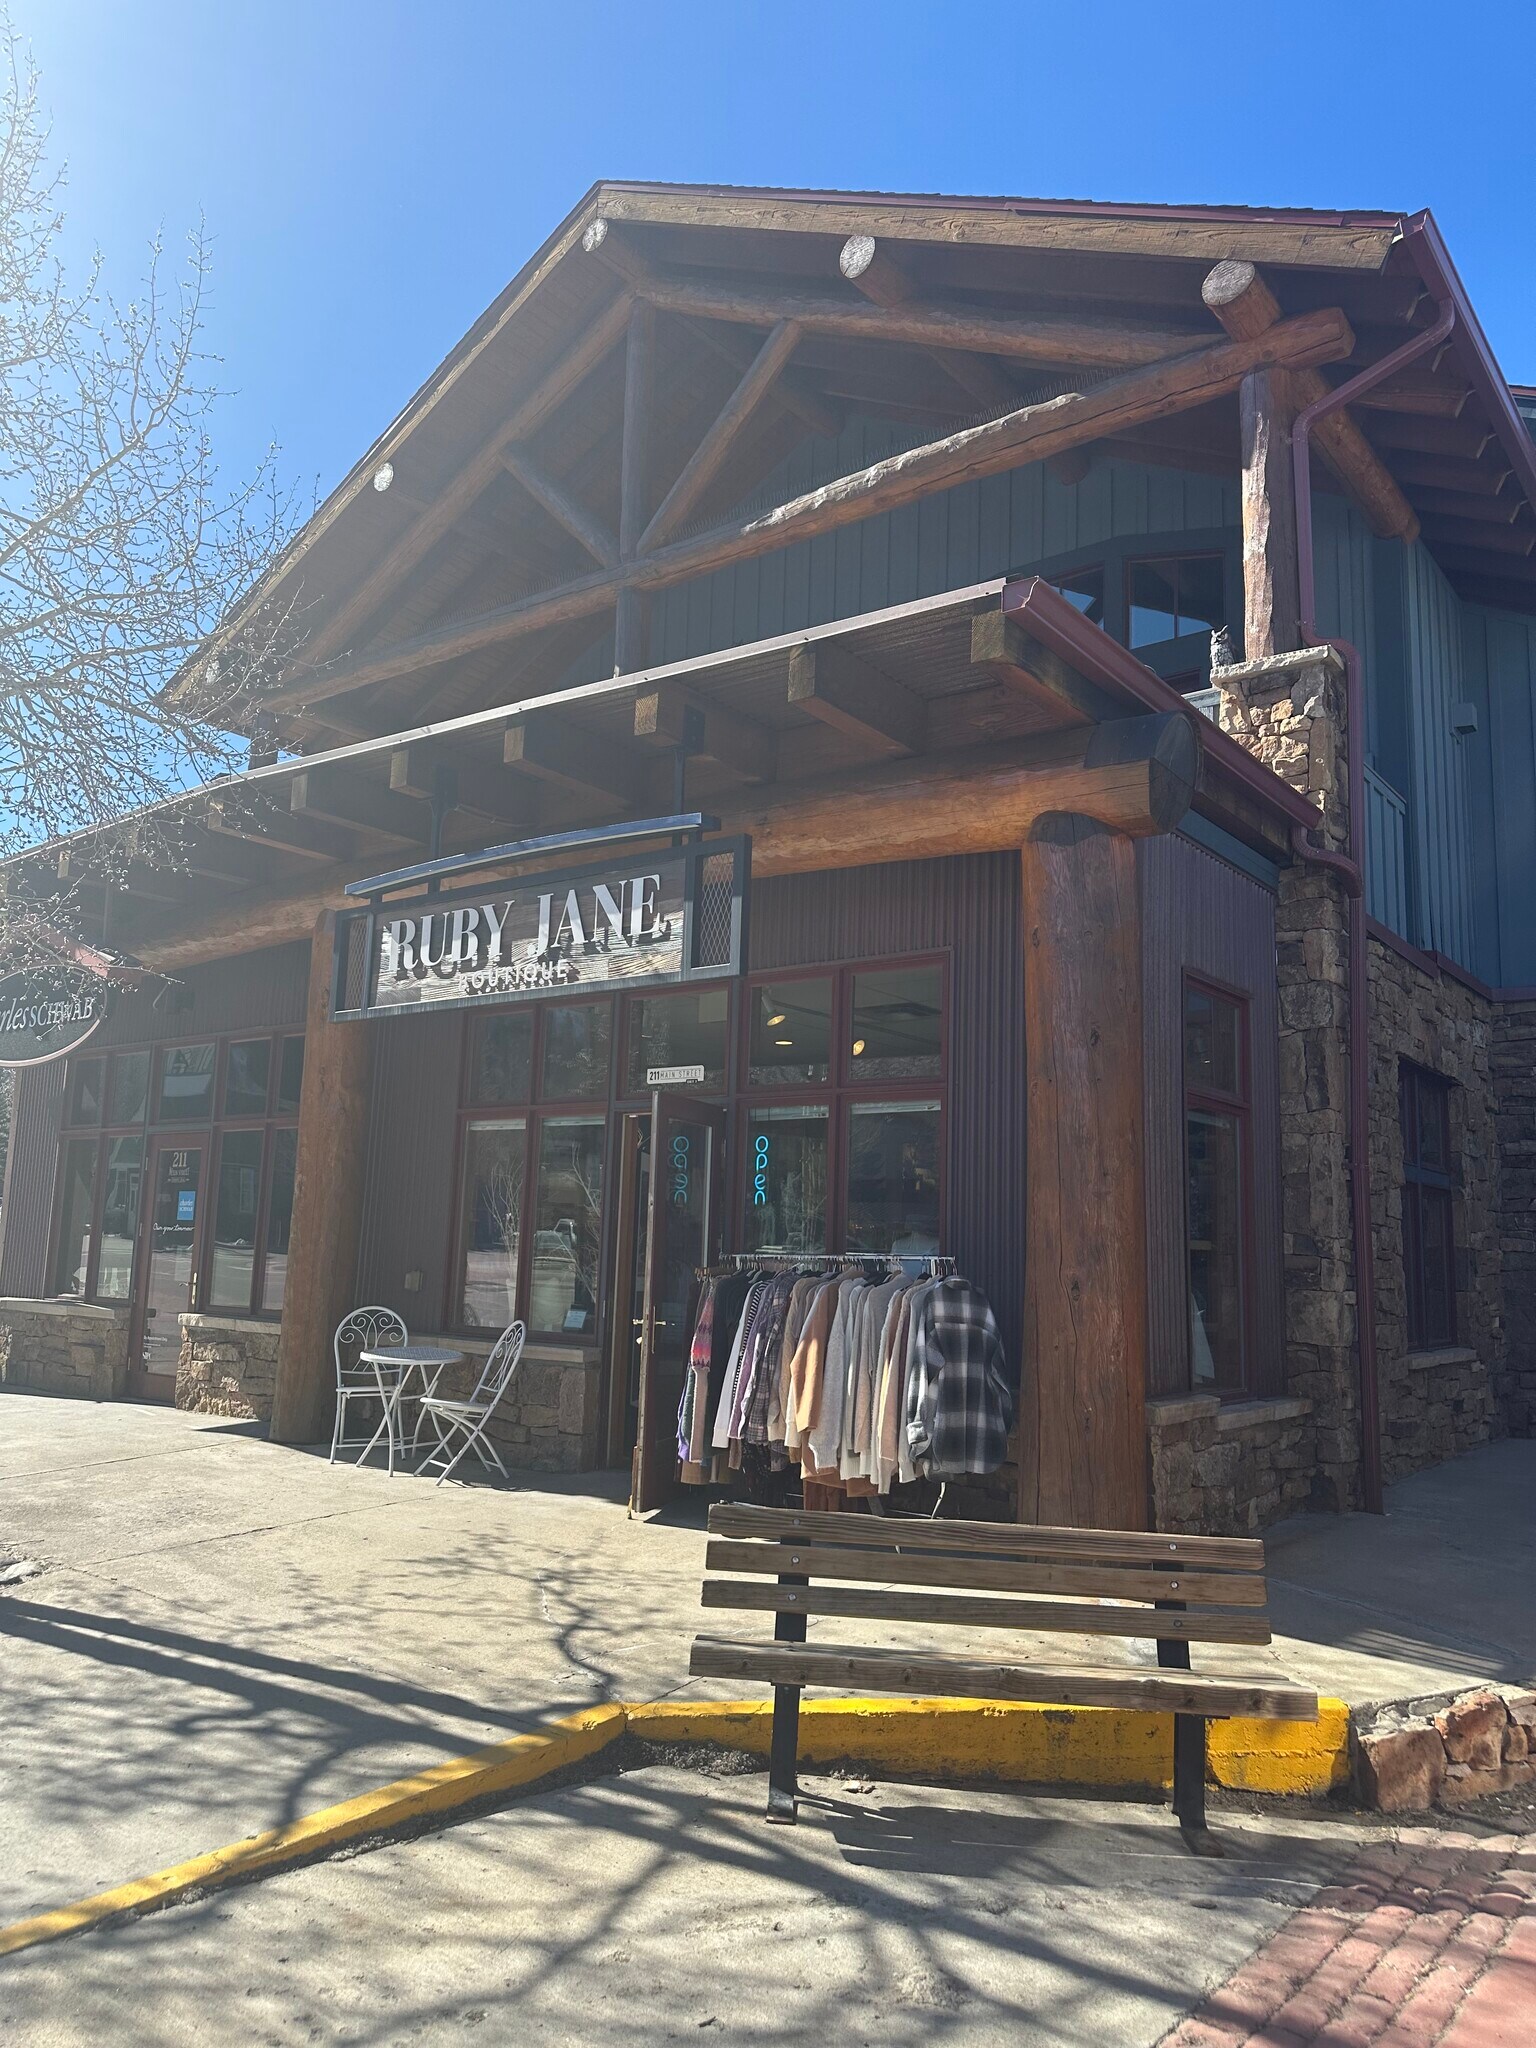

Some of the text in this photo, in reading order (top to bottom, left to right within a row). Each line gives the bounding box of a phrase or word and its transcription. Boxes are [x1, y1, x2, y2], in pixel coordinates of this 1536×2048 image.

[388, 874, 662, 972] RUBY JANE
[458, 958, 569, 990] BOUTIQUE
[649, 1069, 701, 1081] 211 MAIN STREET
[172, 1151, 187, 1168] 211
